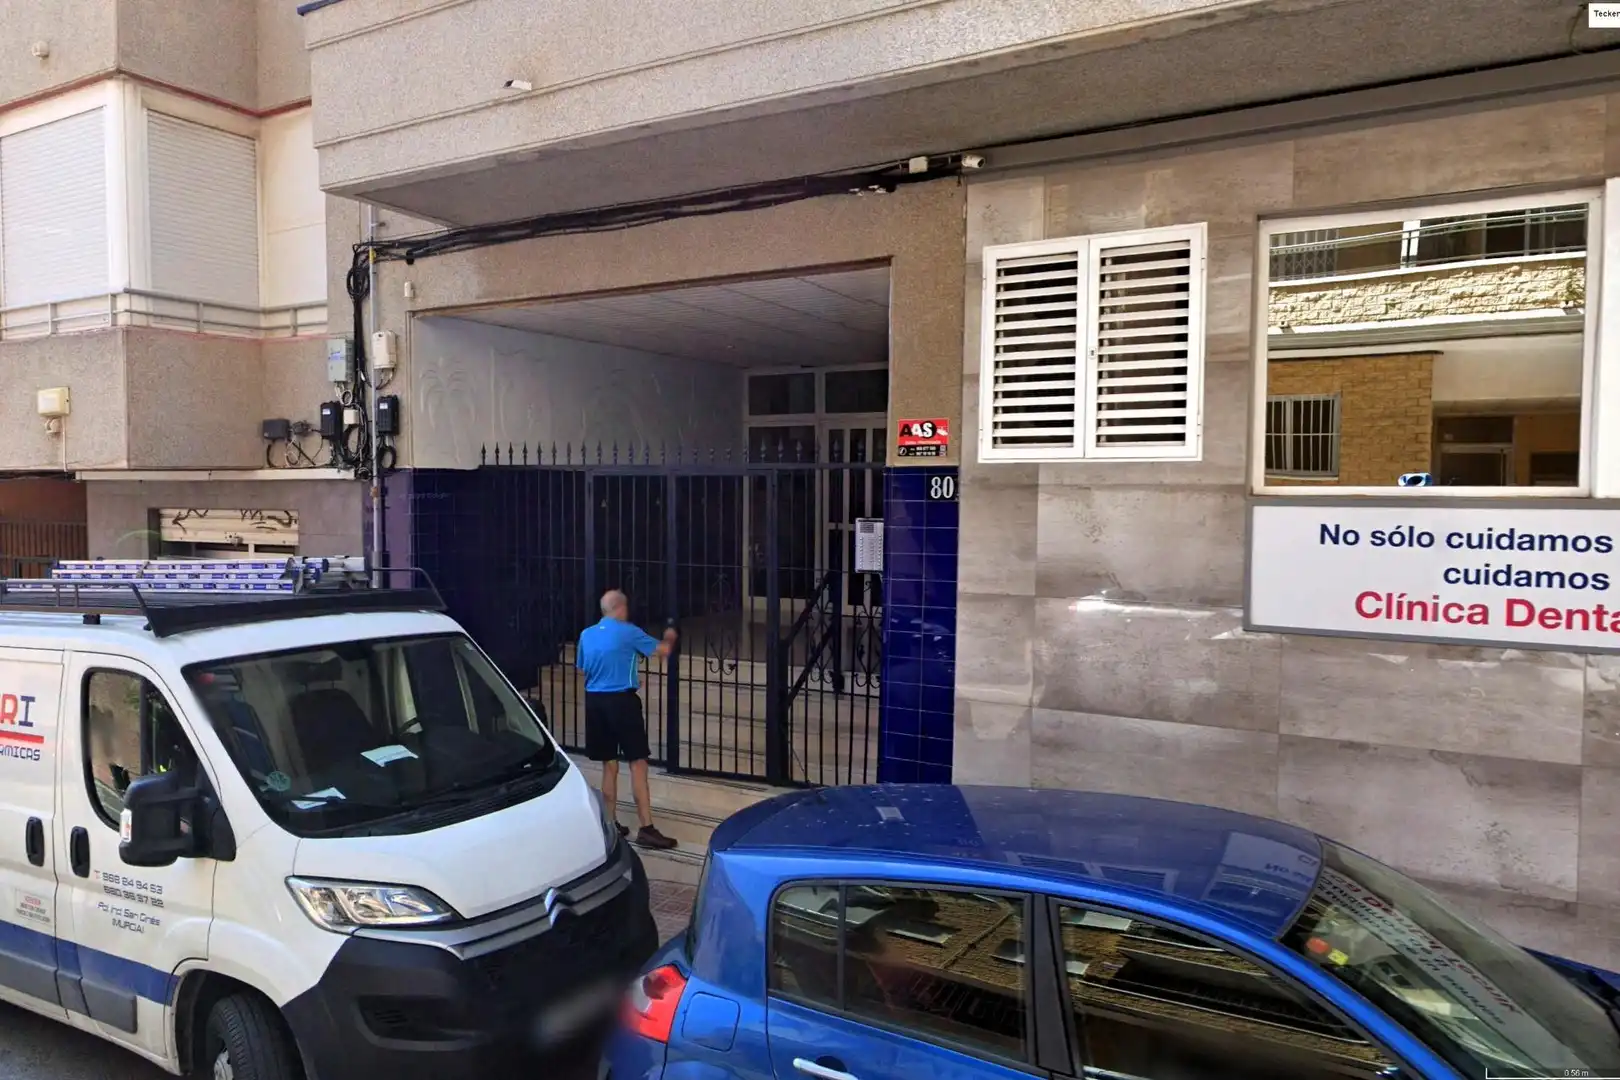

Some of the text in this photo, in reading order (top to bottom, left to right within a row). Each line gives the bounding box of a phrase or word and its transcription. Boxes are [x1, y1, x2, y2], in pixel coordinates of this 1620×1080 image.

[930, 476, 954, 498] 80
[1320, 523, 1613, 553] No sólo cuidamos
[1443, 563, 1611, 591] cuidamos
[1355, 591, 1489, 625] Clínica
